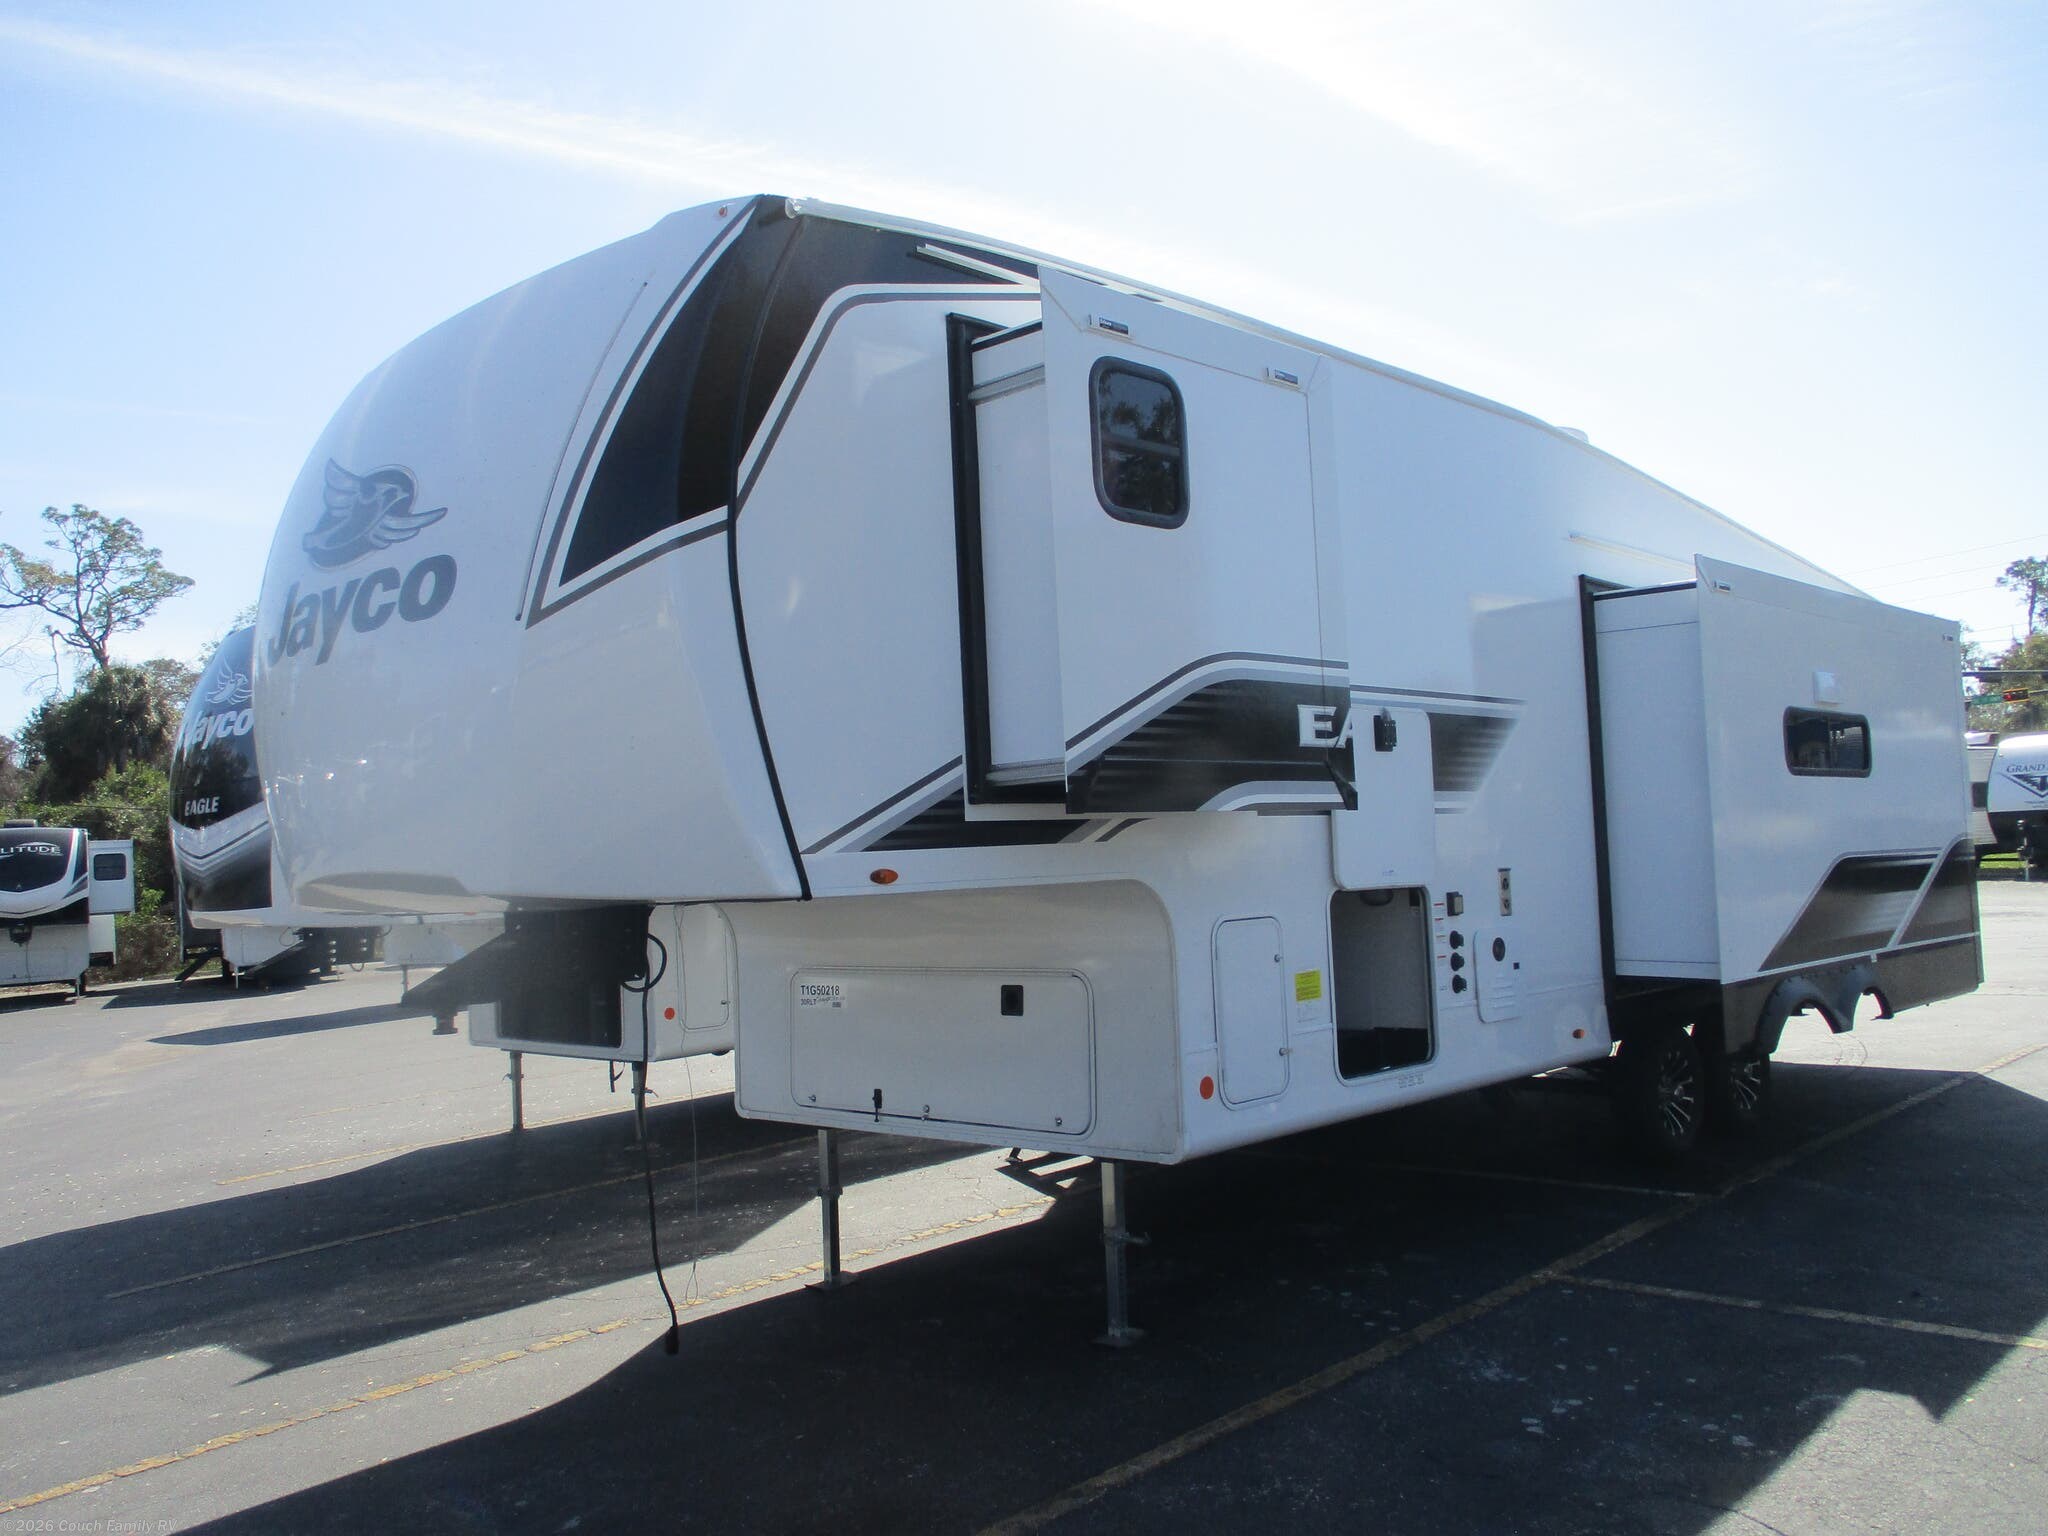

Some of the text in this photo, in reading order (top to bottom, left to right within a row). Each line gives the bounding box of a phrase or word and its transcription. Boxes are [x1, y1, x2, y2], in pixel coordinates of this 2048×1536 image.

[268, 554, 457, 668] Jayco
[185, 708, 254, 750] Jayco
[2006, 764, 2046, 773] GRAND
[184, 797, 220, 817] EAGLE
[800, 984, 840, 996] T1G50218
